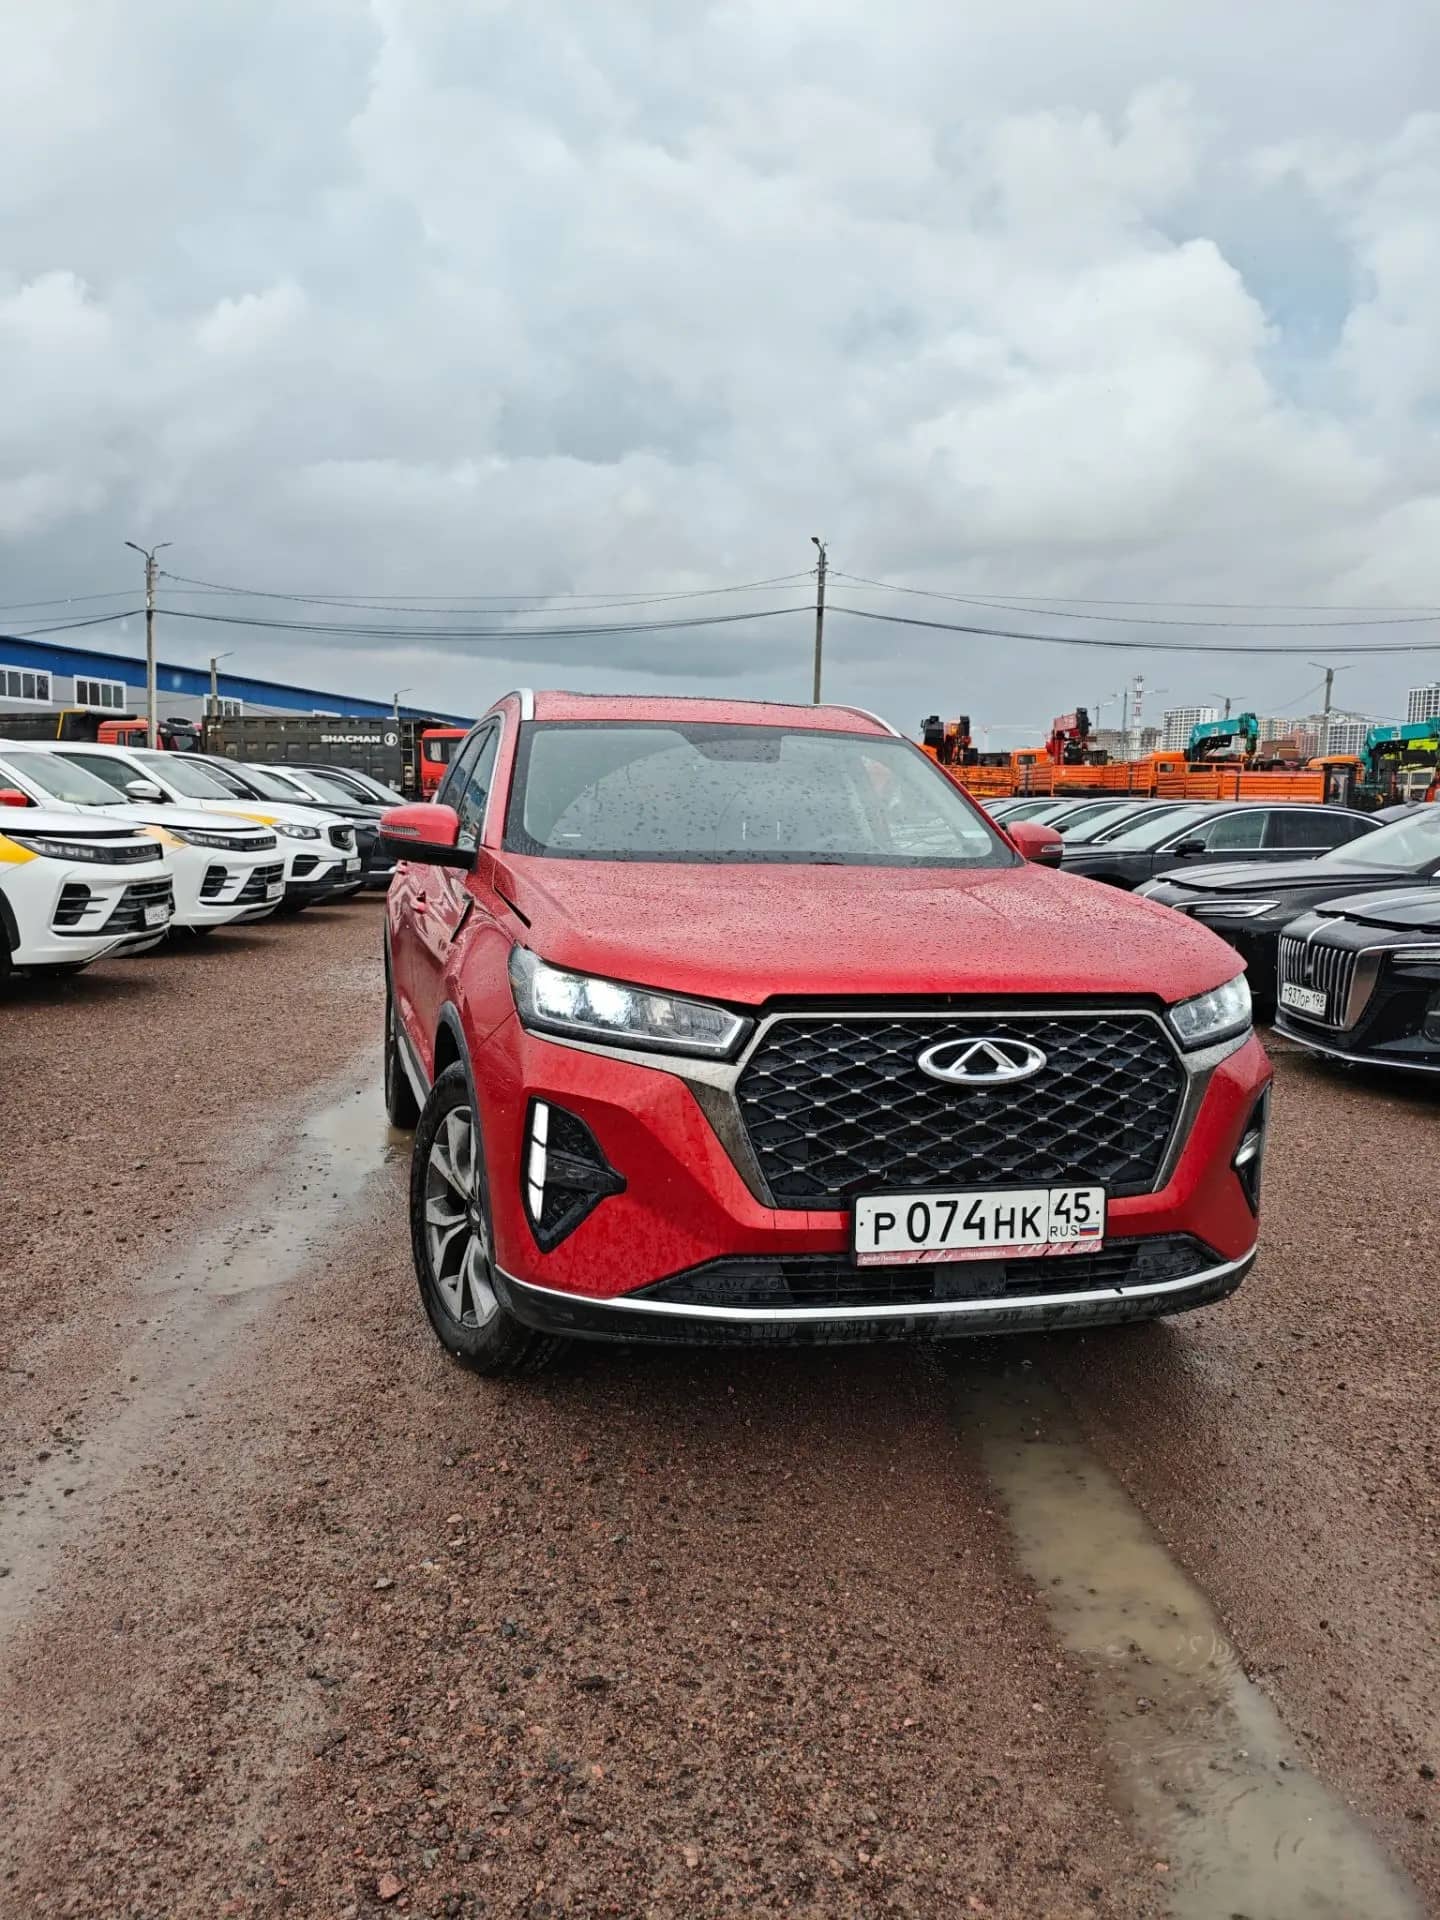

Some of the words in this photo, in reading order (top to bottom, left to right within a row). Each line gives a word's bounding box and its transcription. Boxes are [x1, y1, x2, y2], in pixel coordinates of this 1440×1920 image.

[320, 735, 381, 744] SHACMAN
[1054, 1192, 1091, 1224] 45
[1050, 1224, 1078, 1237] RUS
